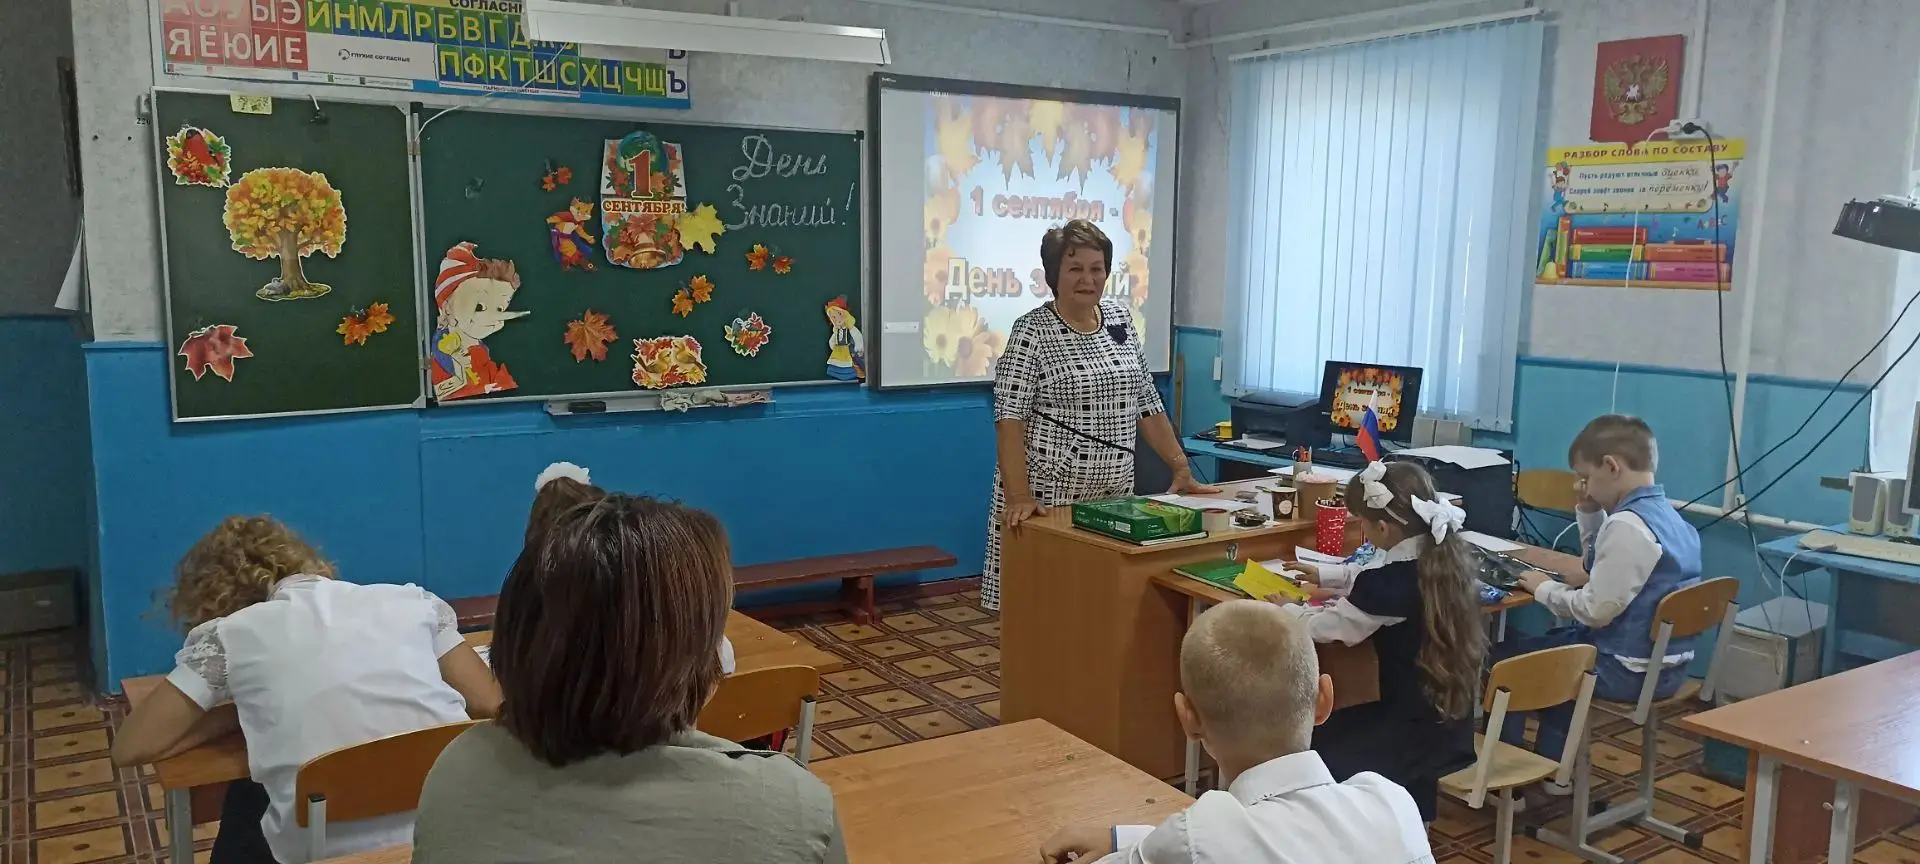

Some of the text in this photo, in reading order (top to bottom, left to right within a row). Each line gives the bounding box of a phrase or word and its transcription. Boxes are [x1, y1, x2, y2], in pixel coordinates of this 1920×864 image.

[450, 0, 523, 13] СОГЛАСН
[732, 134, 828, 180] День
[1564, 150, 1608, 159] РАЗБОР
[1652, 147, 1669, 156] ПО
[1672, 144, 1729, 154] СОСТАВУ
[628, 149, 654, 199] 1
[602, 200, 687, 214] СЕНТЯБРЯ!
[970, 186, 984, 216] 1
[992, 191, 1104, 222] сентября
[944, 257, 1022, 303] День
